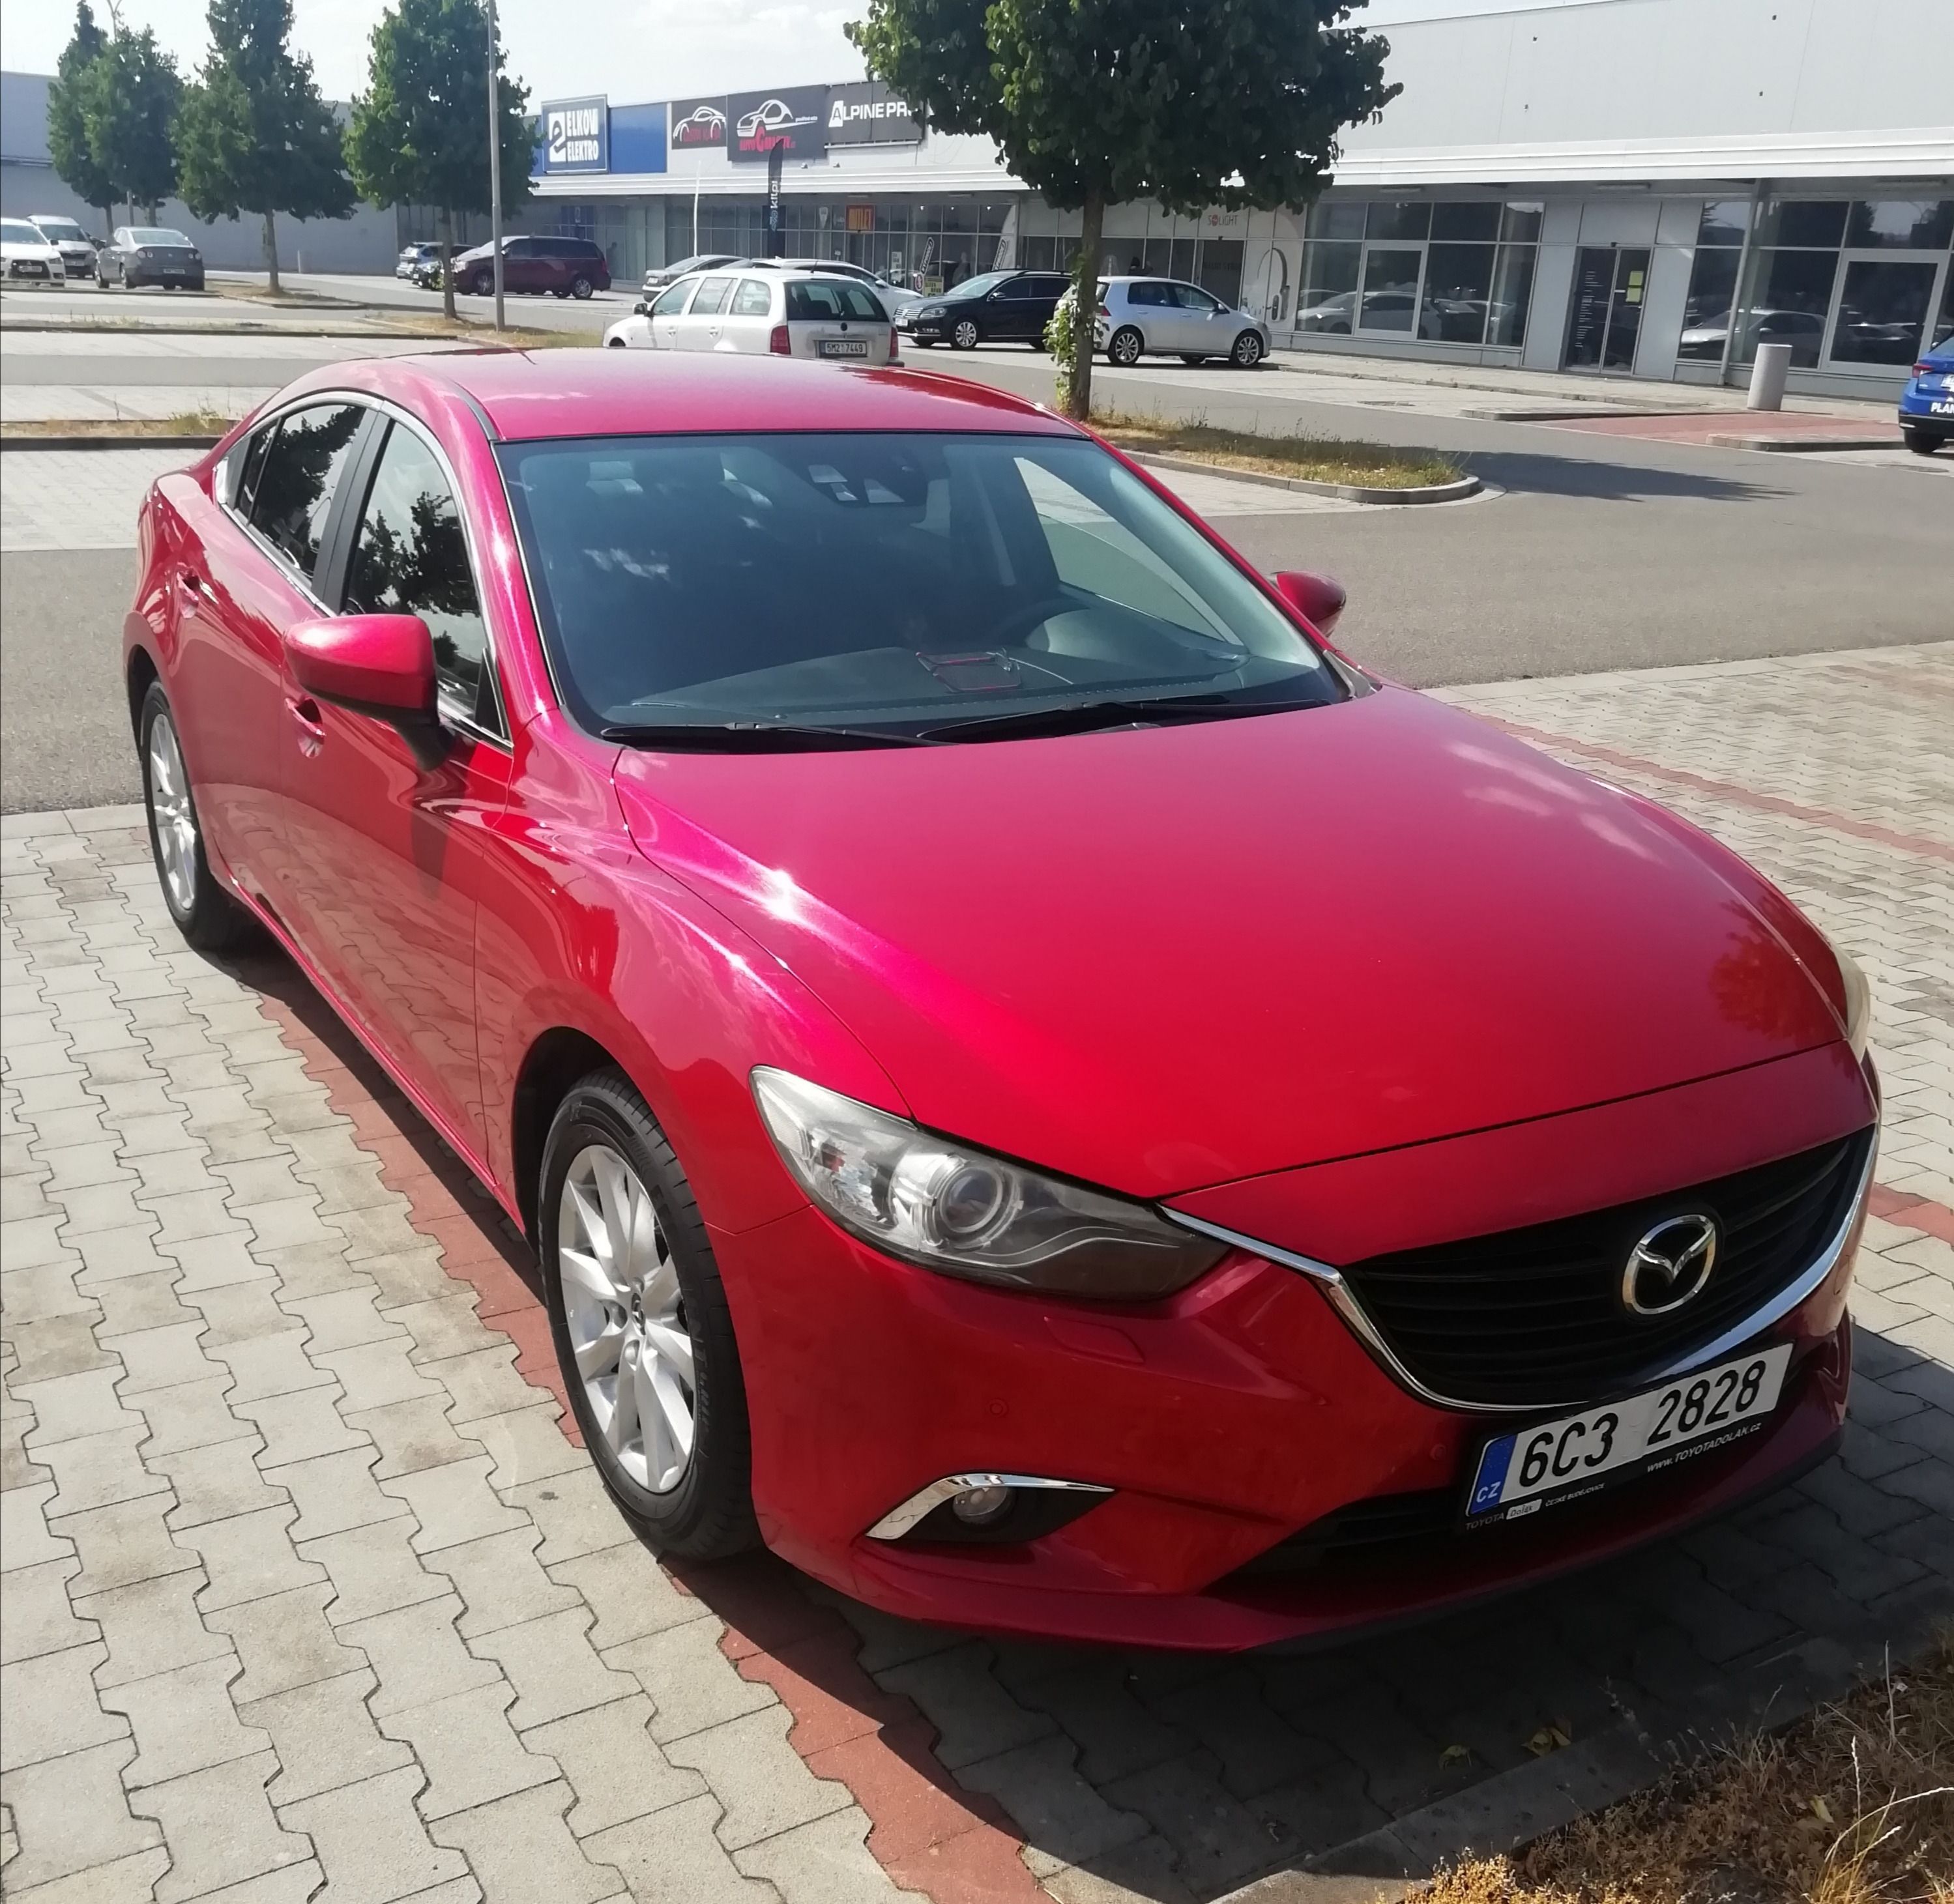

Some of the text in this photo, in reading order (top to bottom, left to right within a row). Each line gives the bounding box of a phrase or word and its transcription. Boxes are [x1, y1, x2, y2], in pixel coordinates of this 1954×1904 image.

[828, 100, 884, 127] ALPINE
[566, 140, 599, 162] ELEKTRO
[1519, 1360, 1766, 1487] 6C3 2828
[1476, 1481, 1501, 1503] CZ
[1465, 1512, 1505, 1531] TOYOTA
